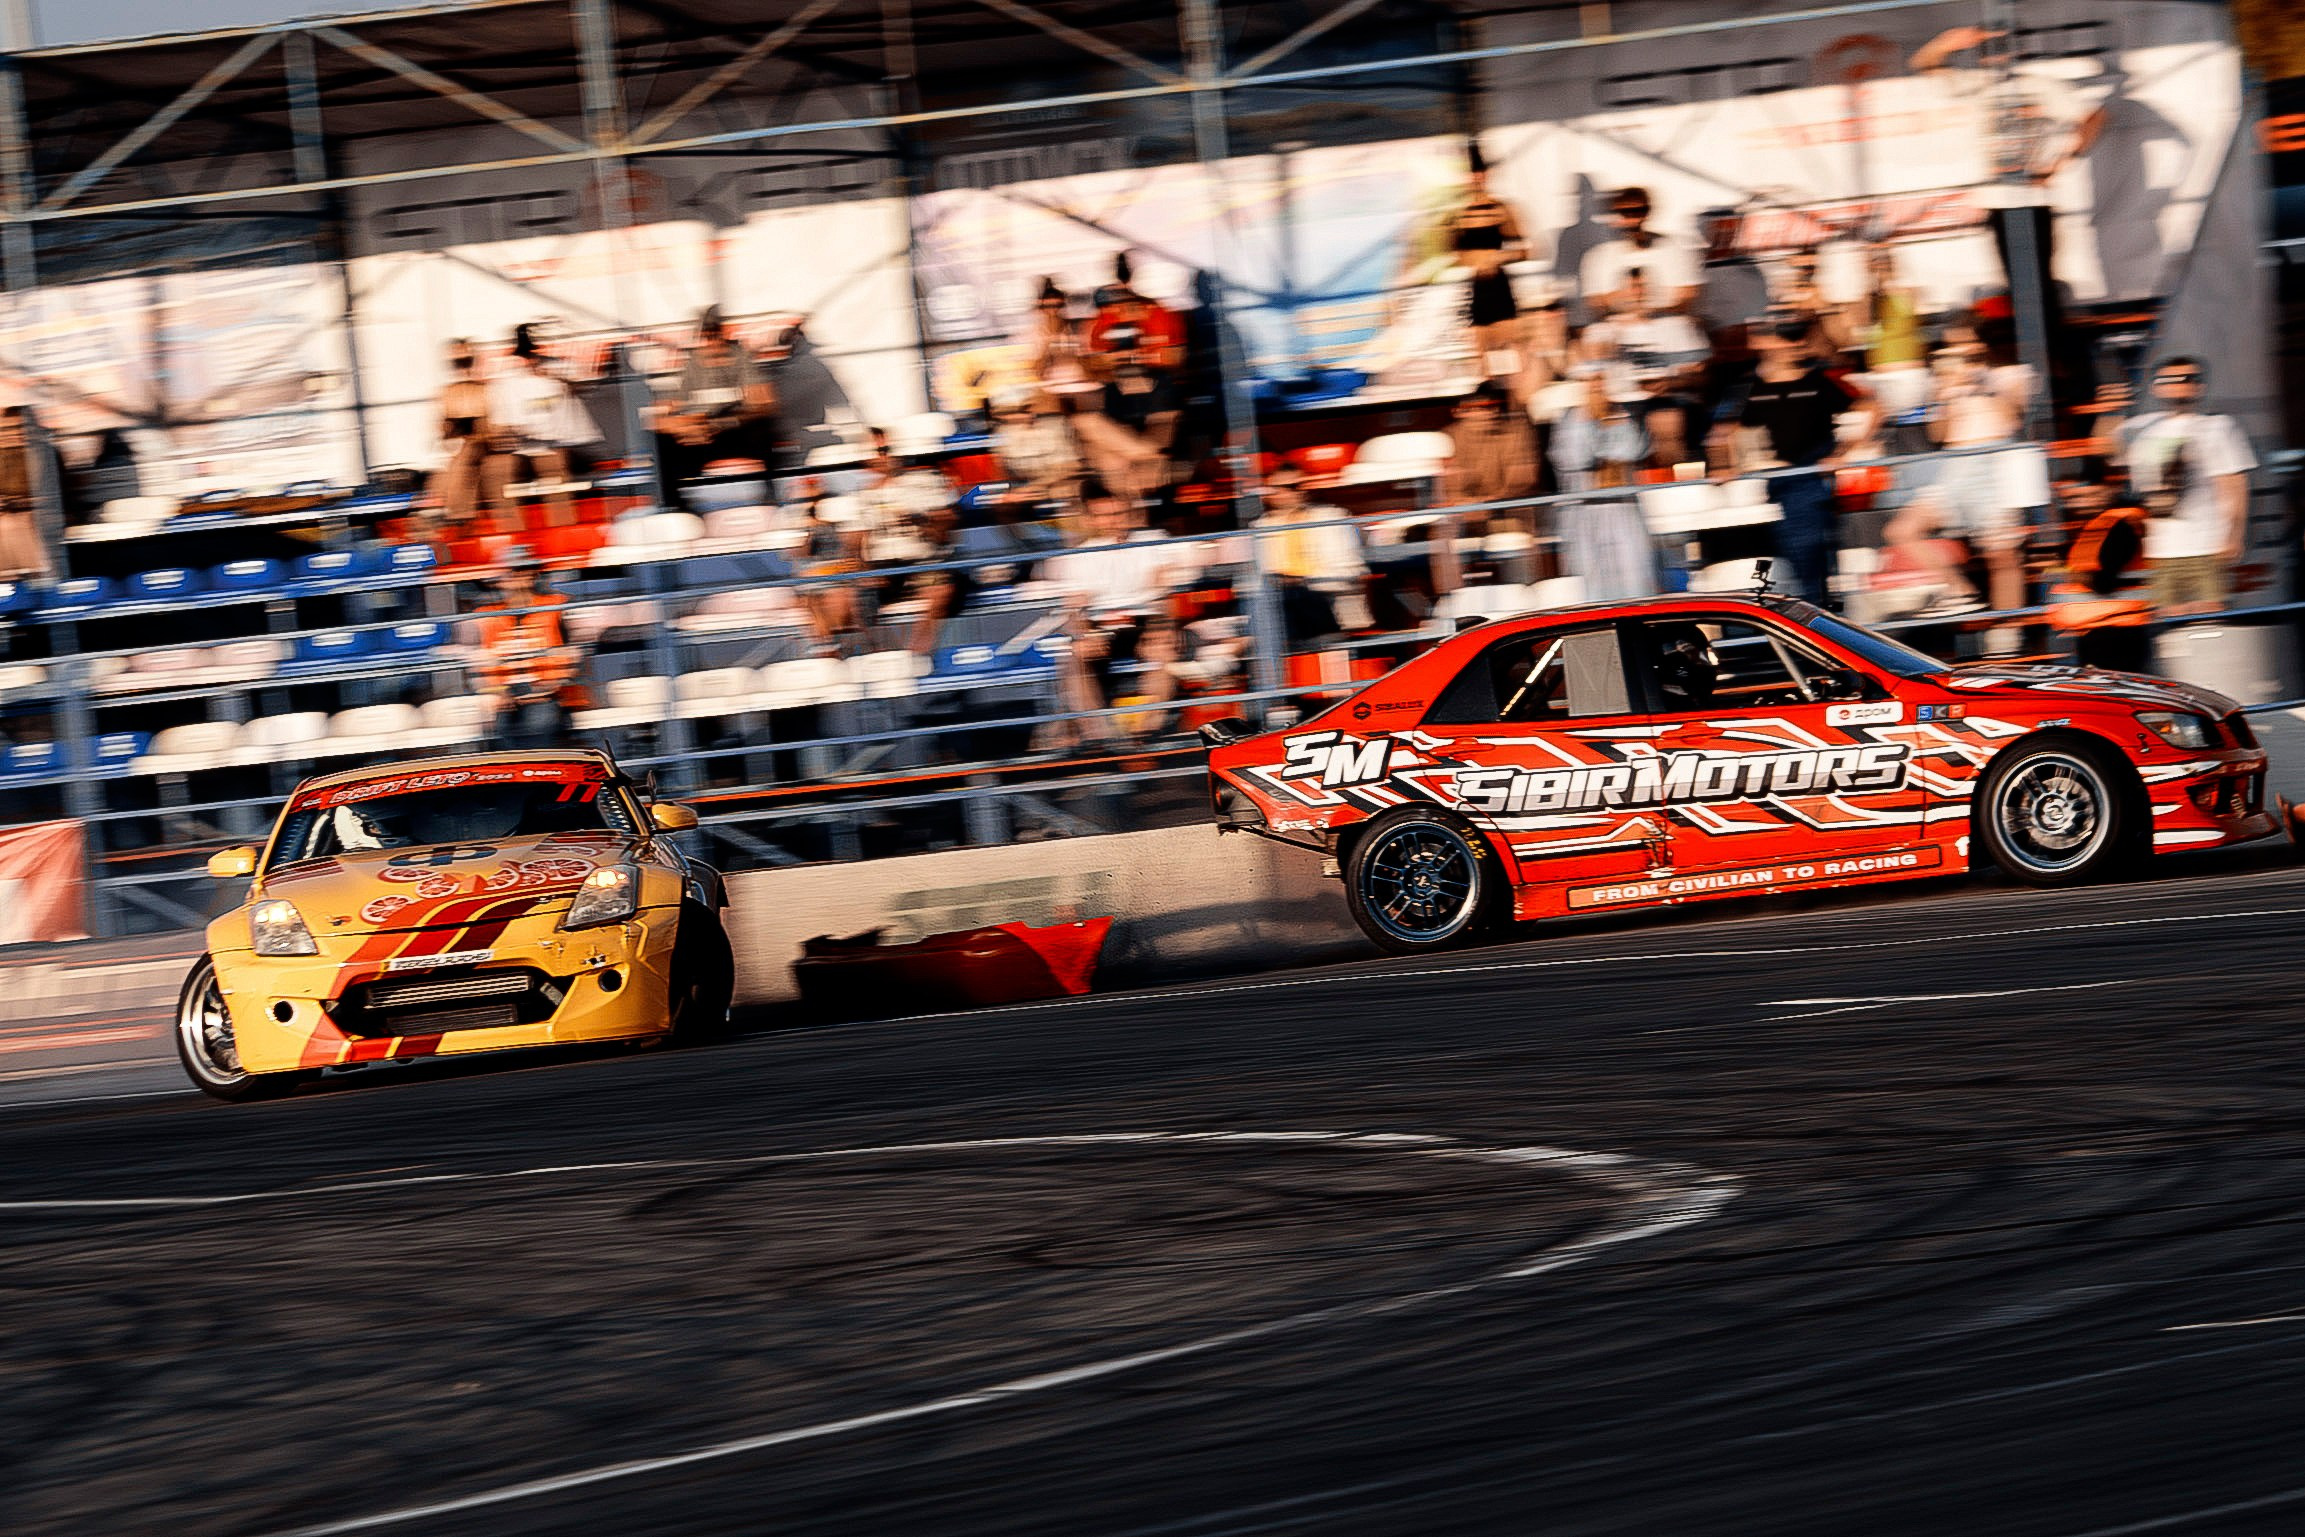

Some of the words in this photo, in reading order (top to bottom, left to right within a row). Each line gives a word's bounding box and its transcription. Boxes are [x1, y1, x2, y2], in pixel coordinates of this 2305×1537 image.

[1282, 731, 1390, 786] SM
[329, 780, 407, 803] DRIFT
[405, 772, 471, 789] LETO
[1592, 883, 1660, 902] FROM
[1668, 870, 1774, 893] CIVILIAN
[1782, 866, 1815, 879] TO
[1824, 854, 1918, 875] RACING
